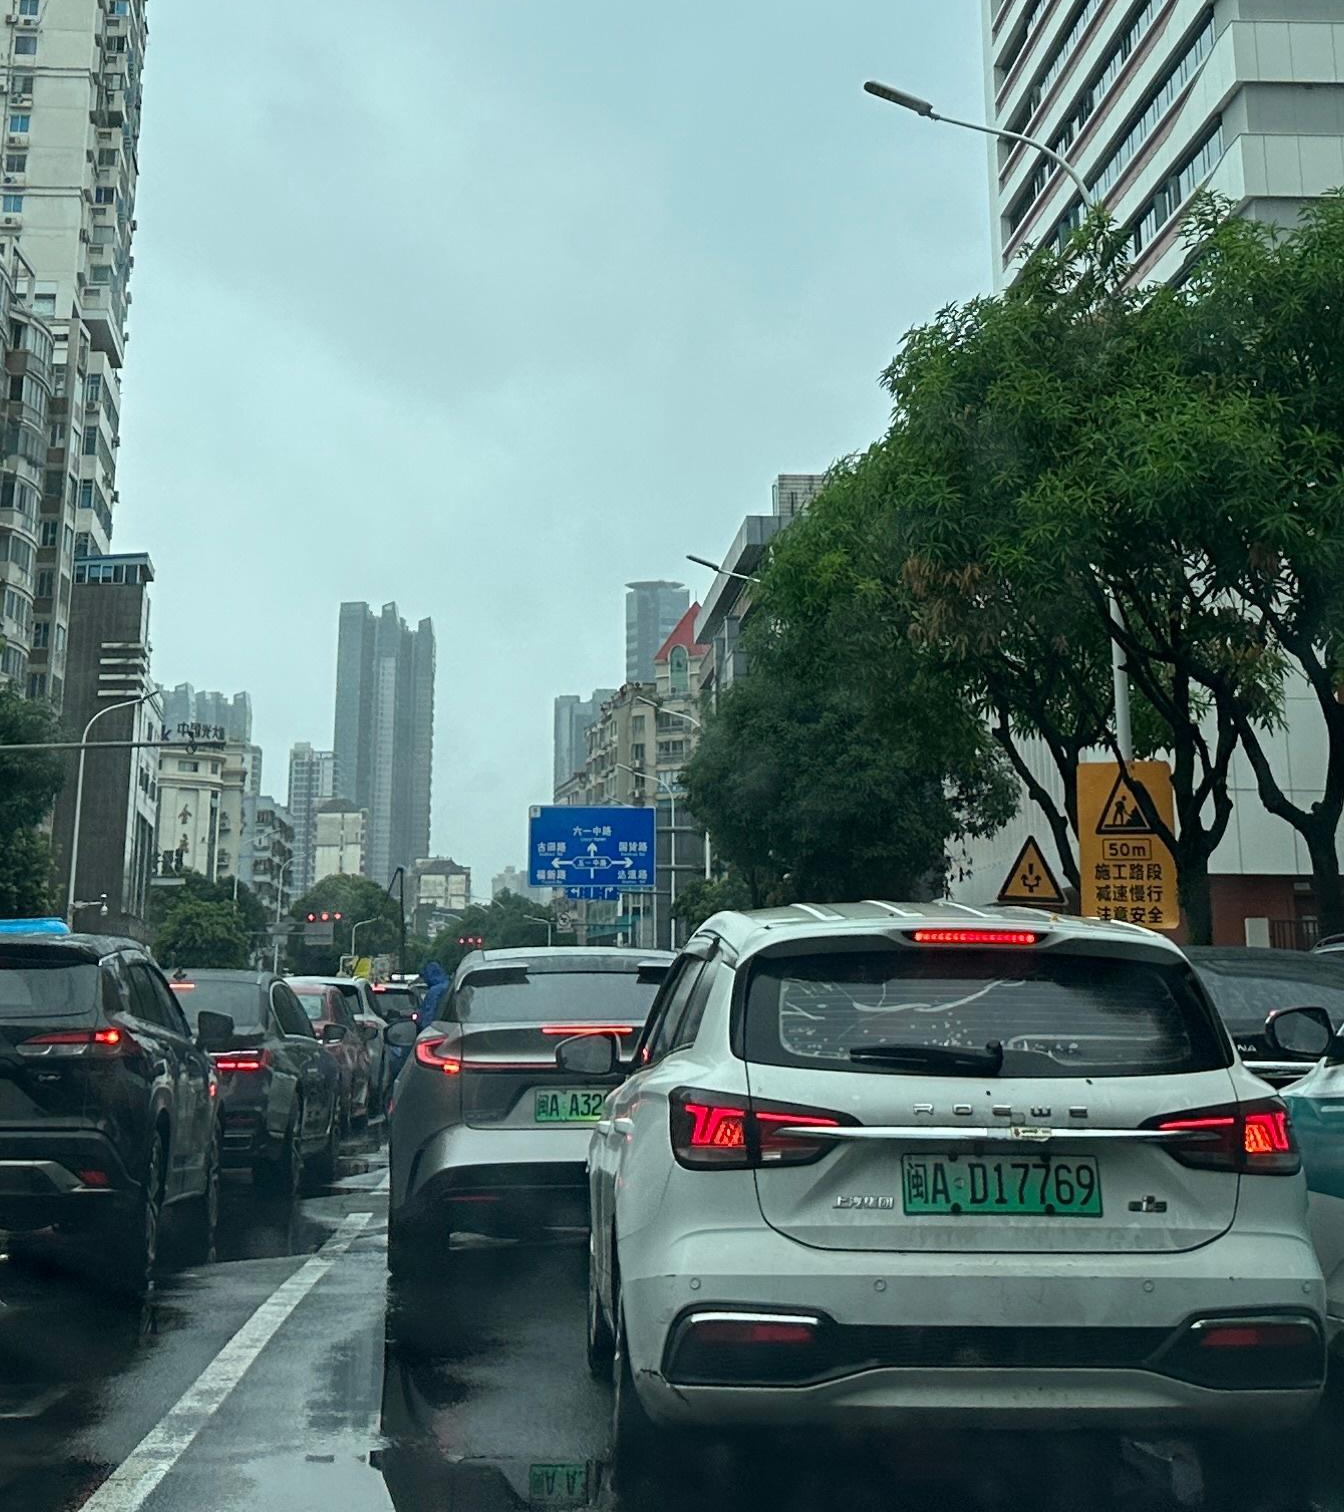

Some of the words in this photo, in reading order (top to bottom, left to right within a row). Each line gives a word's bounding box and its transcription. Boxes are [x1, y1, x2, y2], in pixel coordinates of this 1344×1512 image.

[1108, 843, 1146, 857] 50m
[1094, 863, 1163, 881] 施工路段
[1095, 885, 1164, 903] 减速慢行
[1096, 906, 1164, 924] 注意安全
